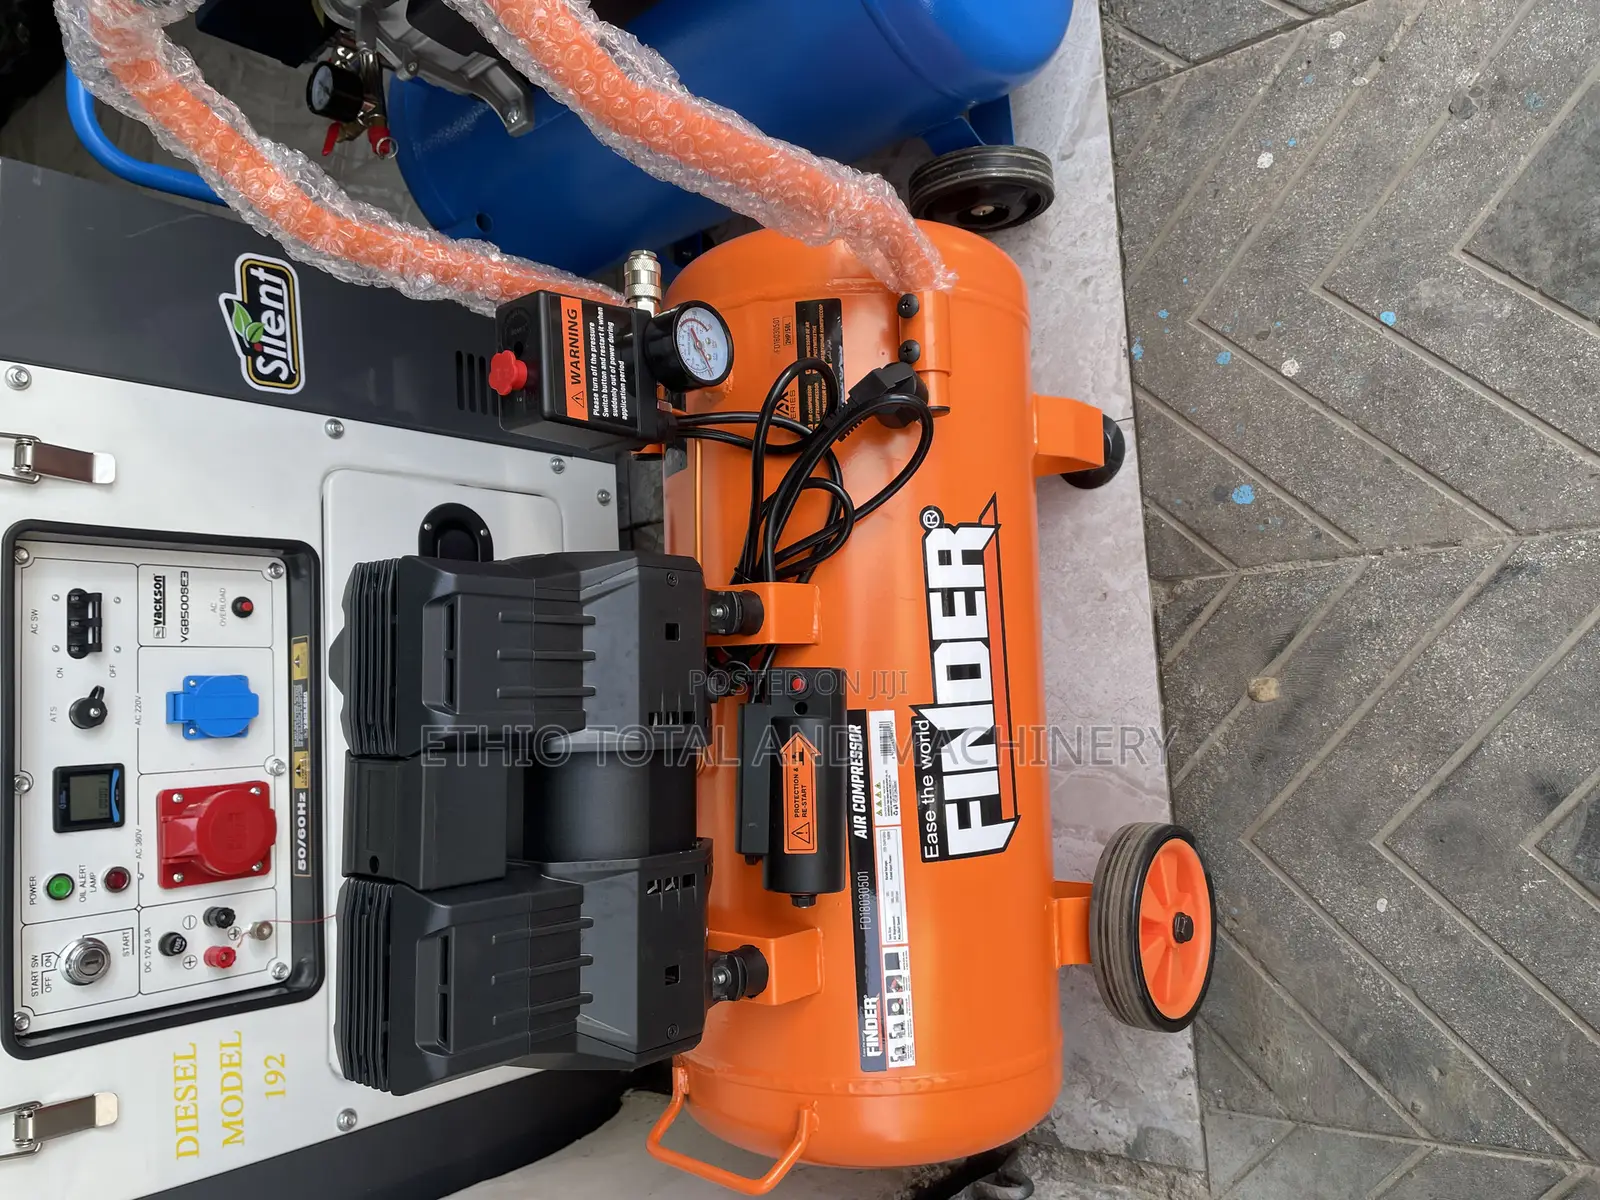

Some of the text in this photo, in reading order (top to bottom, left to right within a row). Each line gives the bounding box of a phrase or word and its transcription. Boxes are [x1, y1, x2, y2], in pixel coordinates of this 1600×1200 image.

[249, 267, 289, 381] Silent
[606, 321, 616, 344] during
[567, 308, 581, 386] WARNING
[608, 343, 617, 366] power
[589, 321, 600, 416] Please turn off the pressure
[601, 371, 609, 393] button
[609, 365, 616, 374] of
[610, 388, 619, 417] suddenly
[618, 360, 628, 420] application period
[789, 389, 797, 420] ERIES
[602, 394, 610, 418] Switch
[31, 608, 38, 635] AC SW
[179, 570, 191, 643] VG8500SE3
[210, 602, 218, 613] AC
[218, 587, 228, 627] OVERLOAD
[56, 667, 64, 679] ON
[109, 663, 117, 679] OFF
[49, 706, 57, 723] ATS
[134, 695, 142, 726] AC 220V
[848, 724, 868, 840] AIR COMPRESSOR
[915, 719, 941, 859] Ease the world
[135, 828, 143, 860] AC 380V
[297, 791, 308, 871] 50/60Hz
[29, 875, 37, 906] POWER
[79, 864, 87, 903] OIL ALERT
[857, 870, 872, 930] FD18030501
[122, 931, 130, 957] START
[144, 945, 152, 959] 12V
[172, 937, 182, 953] FUSE
[31, 954, 39, 997] START SW
[45, 955, 52, 968] ON
[145, 961, 152, 974] DC
[44, 977, 53, 994] OFF
[218, 1030, 245, 1149] MODEL
[263, 1053, 287, 1101] 192
[173, 1042, 200, 1161] DIESEL
